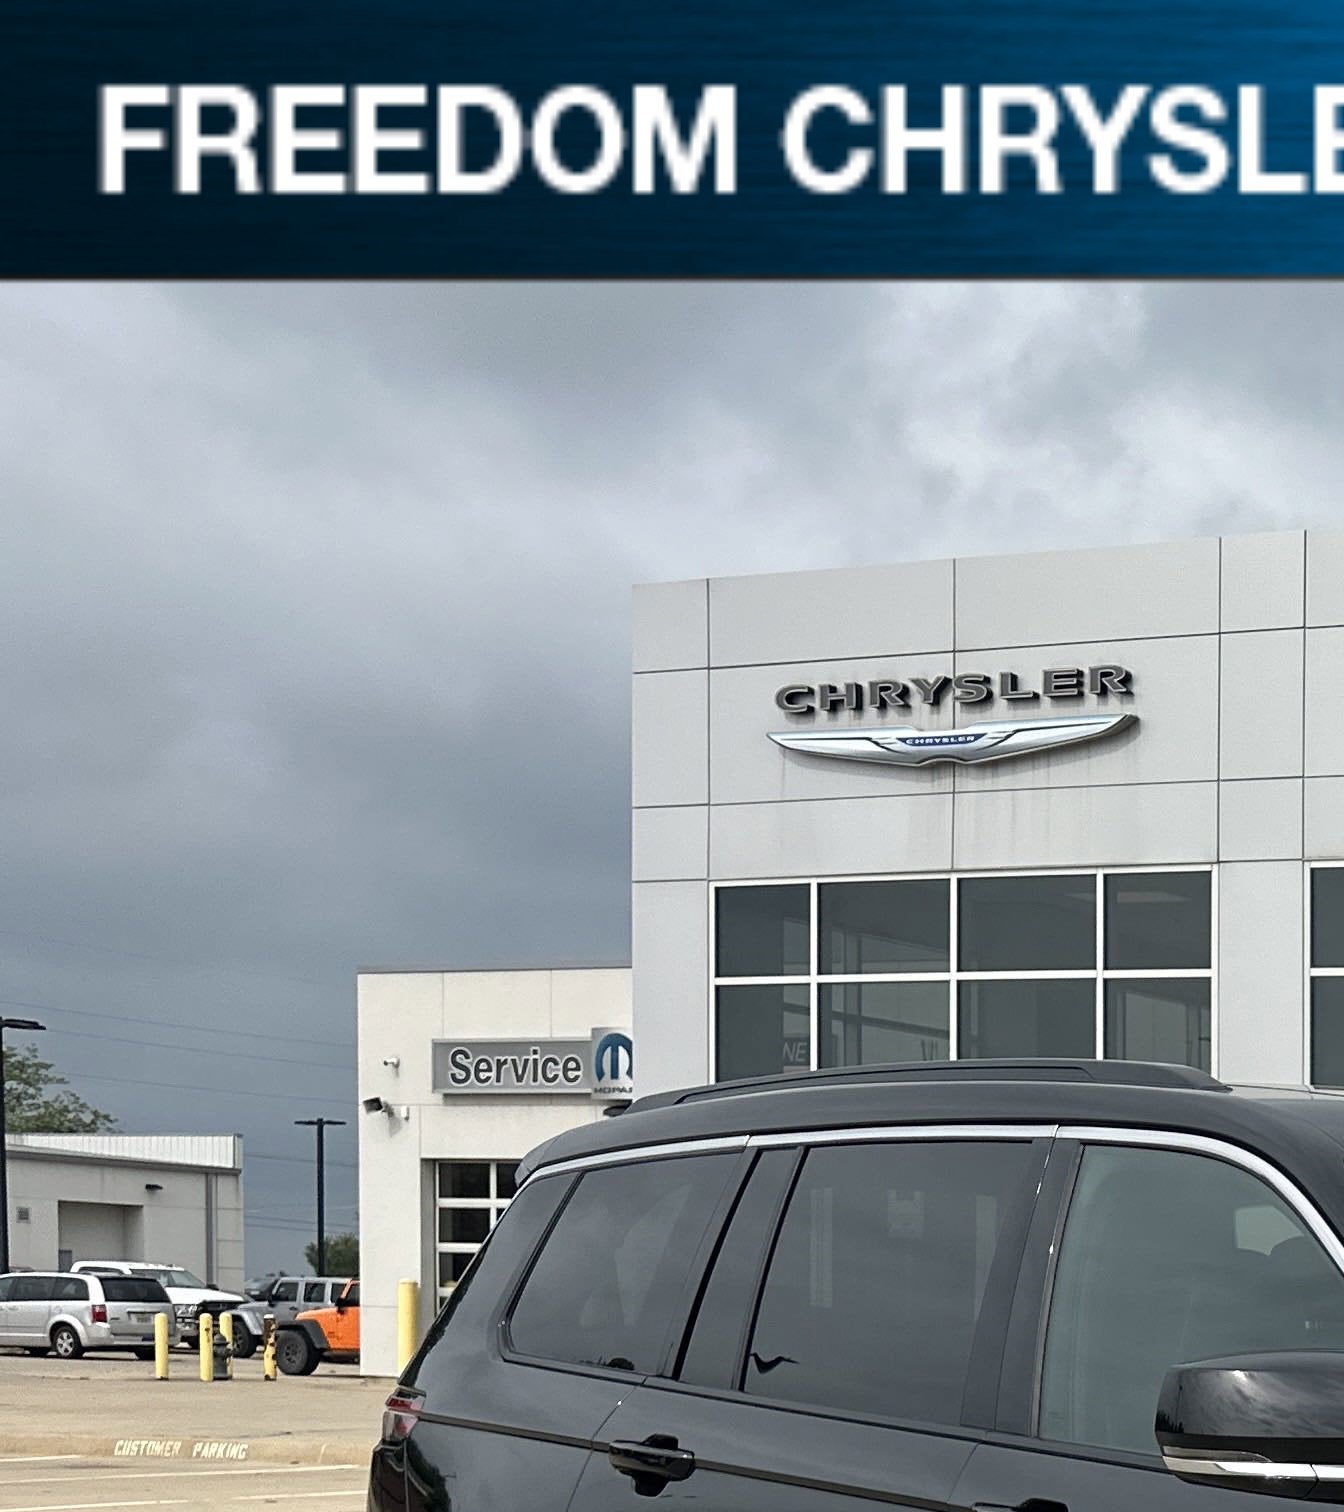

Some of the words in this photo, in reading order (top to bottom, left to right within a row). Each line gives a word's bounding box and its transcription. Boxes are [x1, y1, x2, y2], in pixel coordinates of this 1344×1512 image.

[775, 664, 1134, 714] CHRYSLER
[904, 735, 976, 745] CHRYSLER
[449, 1046, 584, 1086] Service
[114, 1439, 182, 1456] CUSTOMER
[192, 1442, 249, 1460] PARKING
